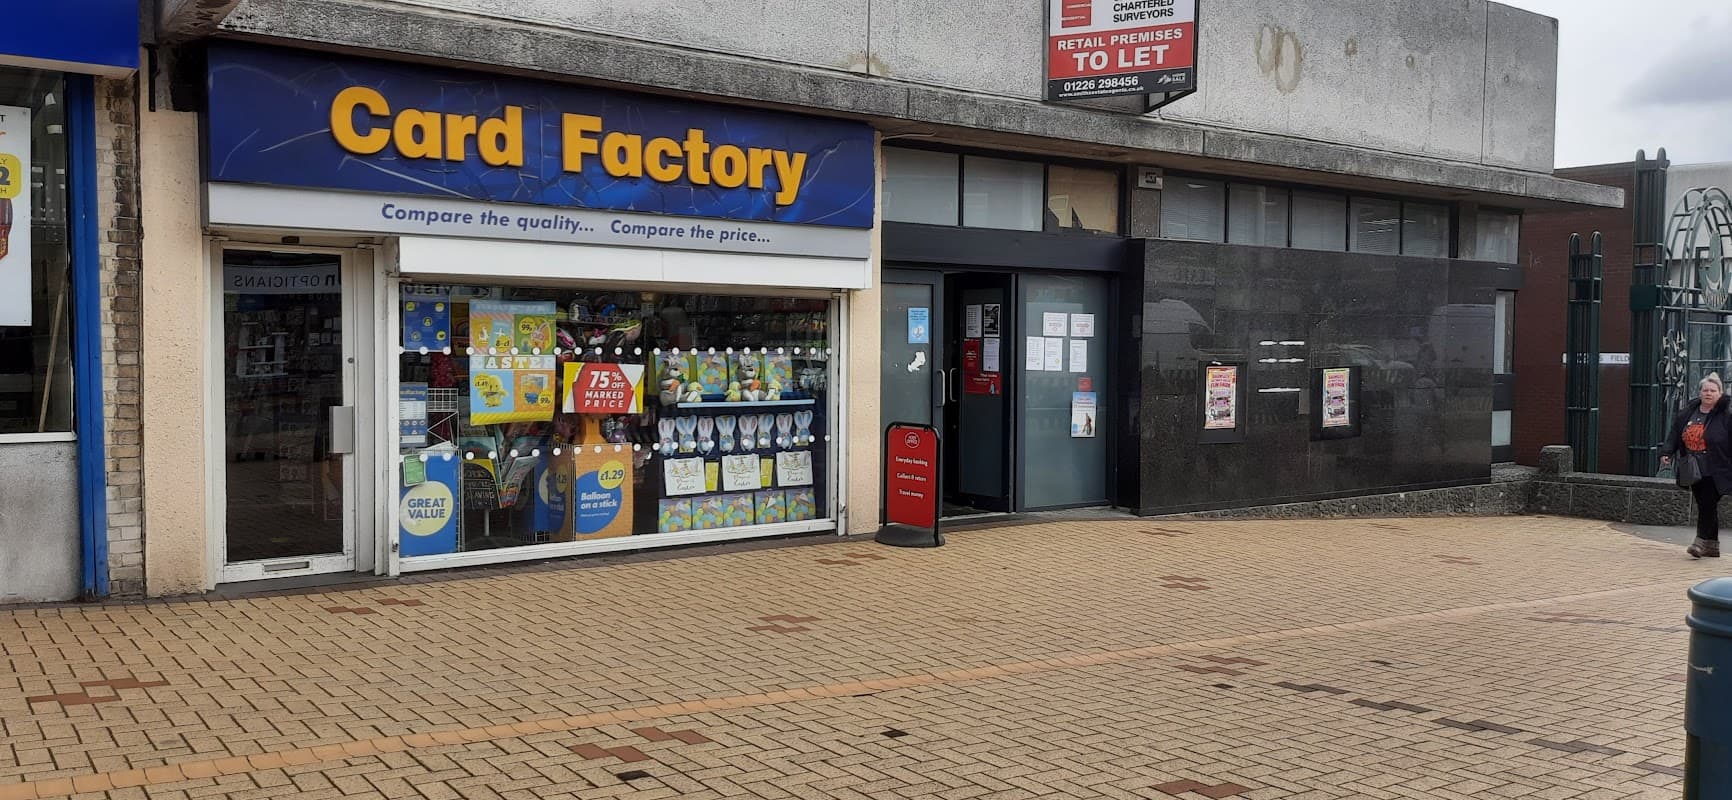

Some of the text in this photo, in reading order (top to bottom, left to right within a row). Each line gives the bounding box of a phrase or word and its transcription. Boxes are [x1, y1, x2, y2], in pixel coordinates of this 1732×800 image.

[1113, 0, 1174, 12] CHARTERED
[1113, 8, 1174, 23] SURVEYORS
[1057, 28, 1183, 50] RETAIL PREMISES
[1073, 45, 1169, 72] TO LET
[1064, 76, 1139, 92] 01226 298456
[330, 86, 808, 206] Card Factory
[381, 203, 771, 243] Compare the quality... Compare the price...
[585, 391, 625, 399] MARKED
[584, 400, 624, 408] PRICE
[600, 469, 624, 481] £1.29
[581, 492, 611, 501] Balloon
[407, 498, 446, 508] GREAT
[599, 498, 617, 508] stick
[408, 508, 446, 519] VALUE
